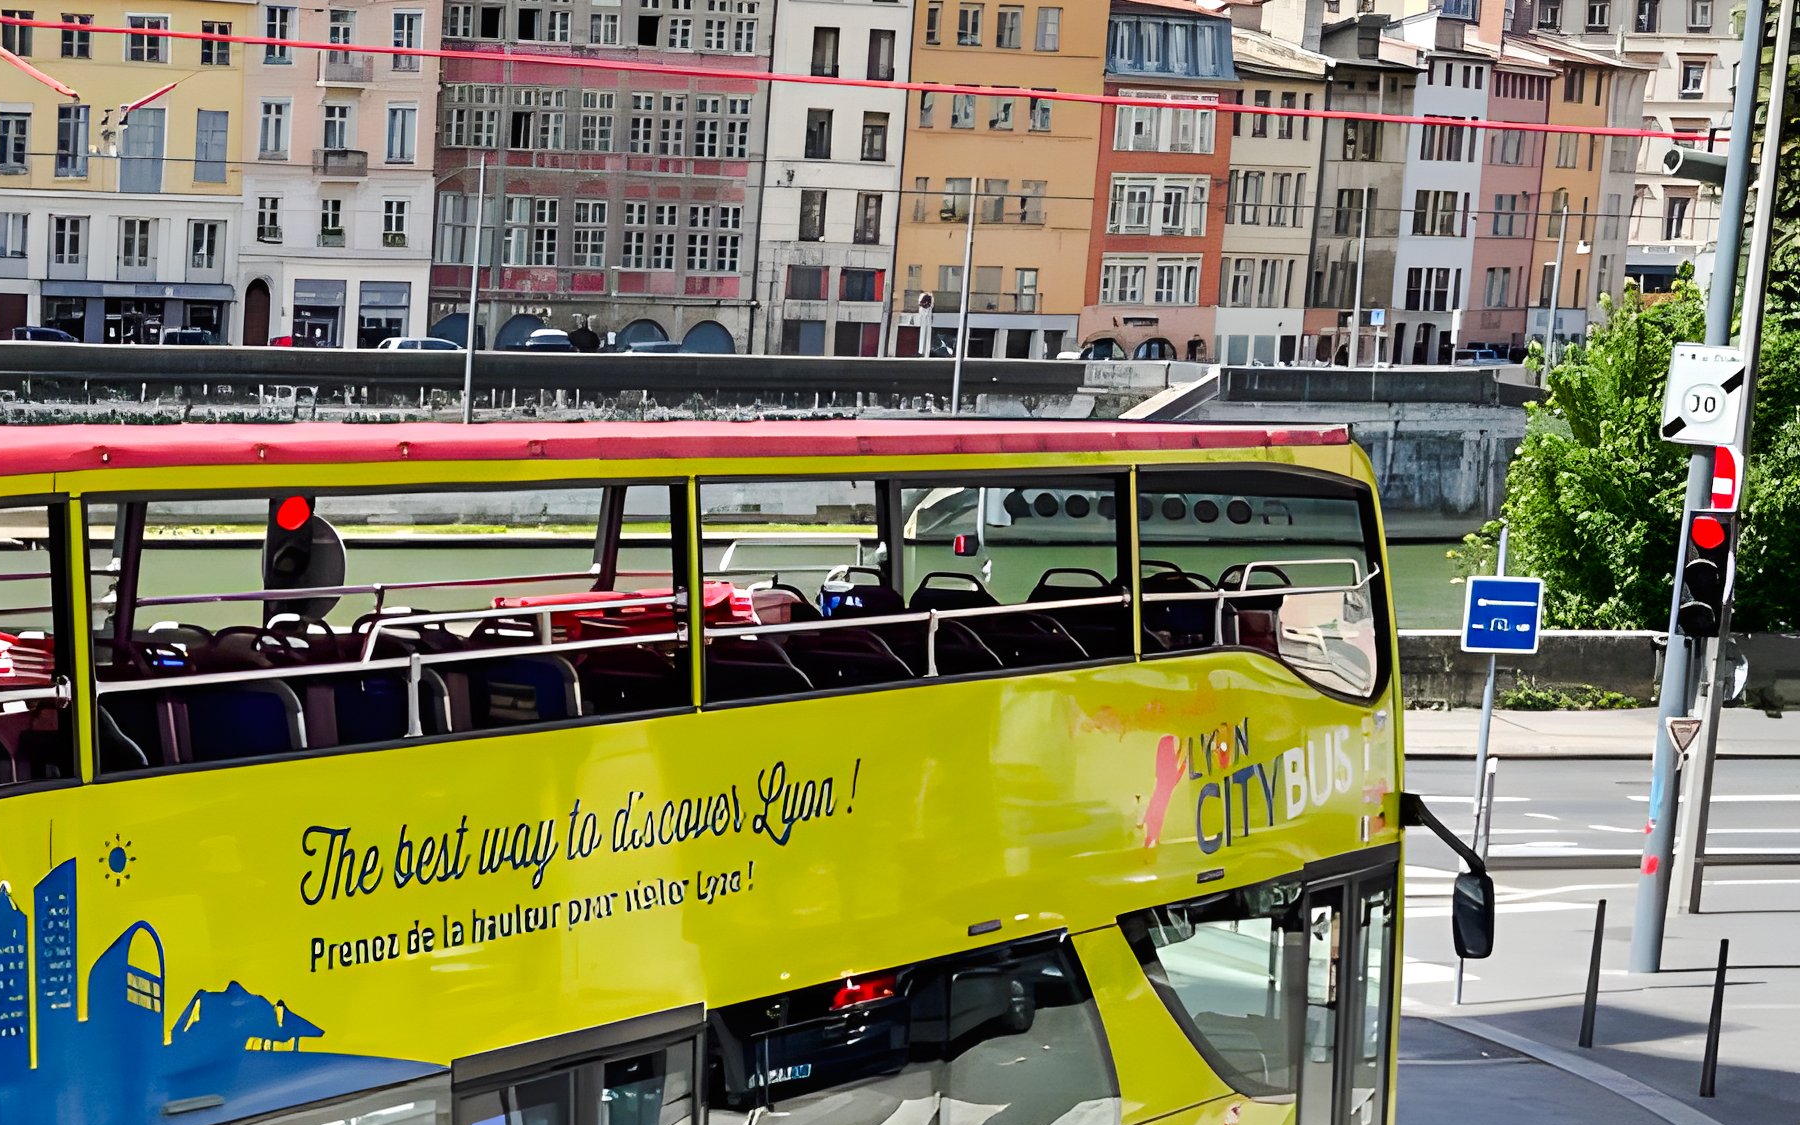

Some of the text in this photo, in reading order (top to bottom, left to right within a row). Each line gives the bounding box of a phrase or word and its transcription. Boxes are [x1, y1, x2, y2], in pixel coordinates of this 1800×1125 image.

[1188, 716, 1250, 781] LYON
[299, 824, 384, 906] The
[394, 814, 472, 889] best
[478, 818, 560, 890] way
[566, 798, 603, 860] to
[612, 784, 747, 852] discover
[752, 760, 838, 847] Lyon
[406, 919, 436, 956] de
[442, 914, 465, 949] la
